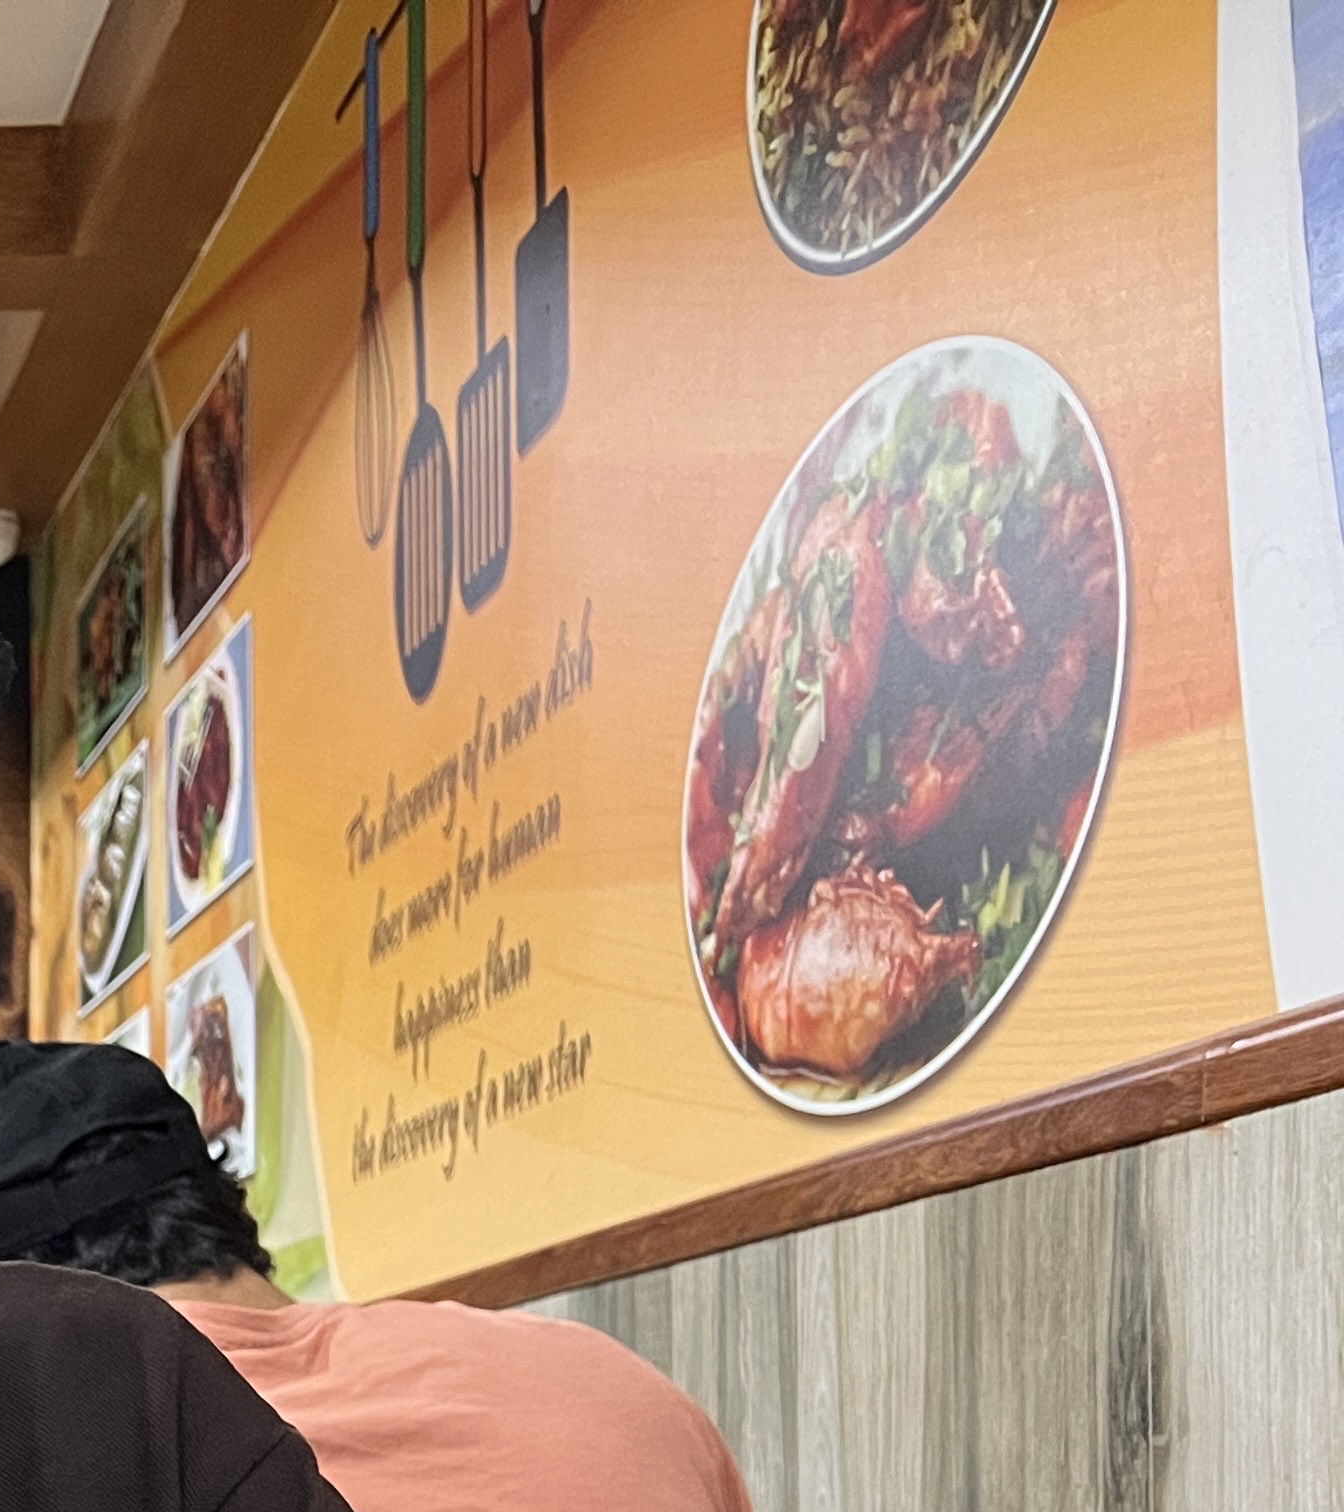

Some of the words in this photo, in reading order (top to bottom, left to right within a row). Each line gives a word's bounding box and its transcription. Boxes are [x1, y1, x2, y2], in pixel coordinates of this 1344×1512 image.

[380, 755, 458, 840] discovery
[463, 694, 486, 804] of
[484, 721, 498, 773] a
[502, 680, 541, 755] new
[545, 597, 593, 721] dish
[454, 826, 484, 931] for
[488, 792, 561, 882] human
[394, 980, 481, 1084] happiness
[485, 916, 531, 1009] than
[379, 1092, 459, 1181] discovery
[464, 1048, 486, 1154] of
[486, 1078, 498, 1128] a
[503, 1053, 543, 1119] new
[546, 1018, 591, 1100] star
